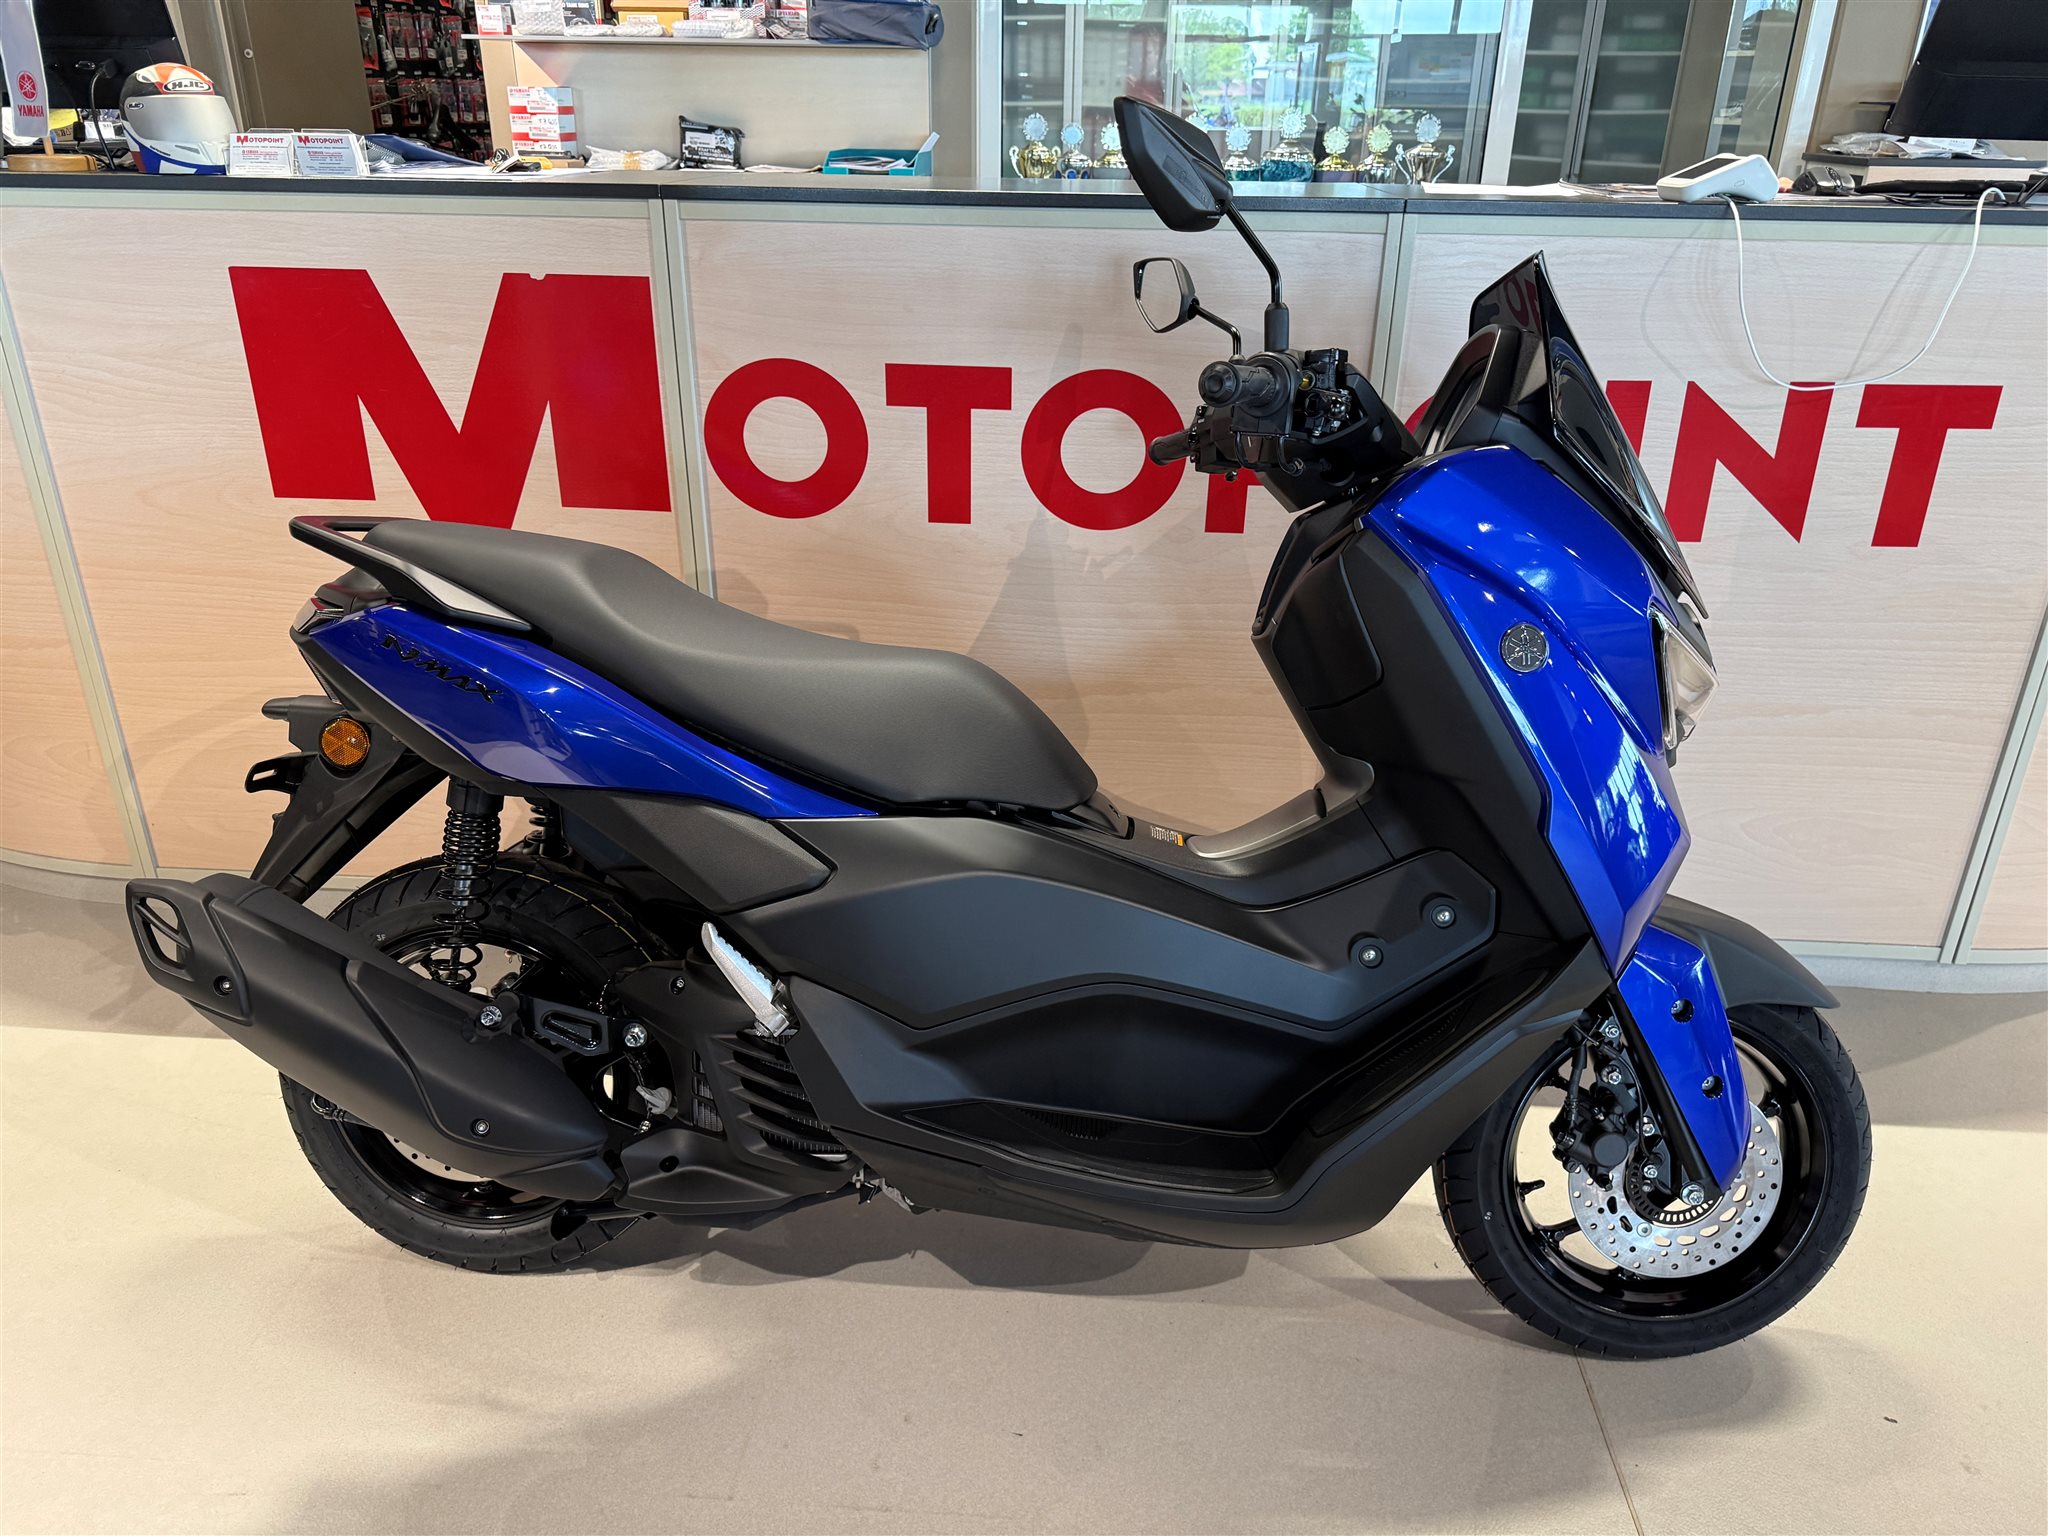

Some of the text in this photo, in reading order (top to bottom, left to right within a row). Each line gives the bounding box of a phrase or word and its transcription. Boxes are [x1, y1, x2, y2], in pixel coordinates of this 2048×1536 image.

[171, 81, 205, 89] HJC
[18, 104, 44, 117] YAMAHA
[236, 135, 284, 145] MOTOPOINT
[297, 135, 343, 146] MOTOPOINT
[229, 267, 2002, 548] MOTONT
